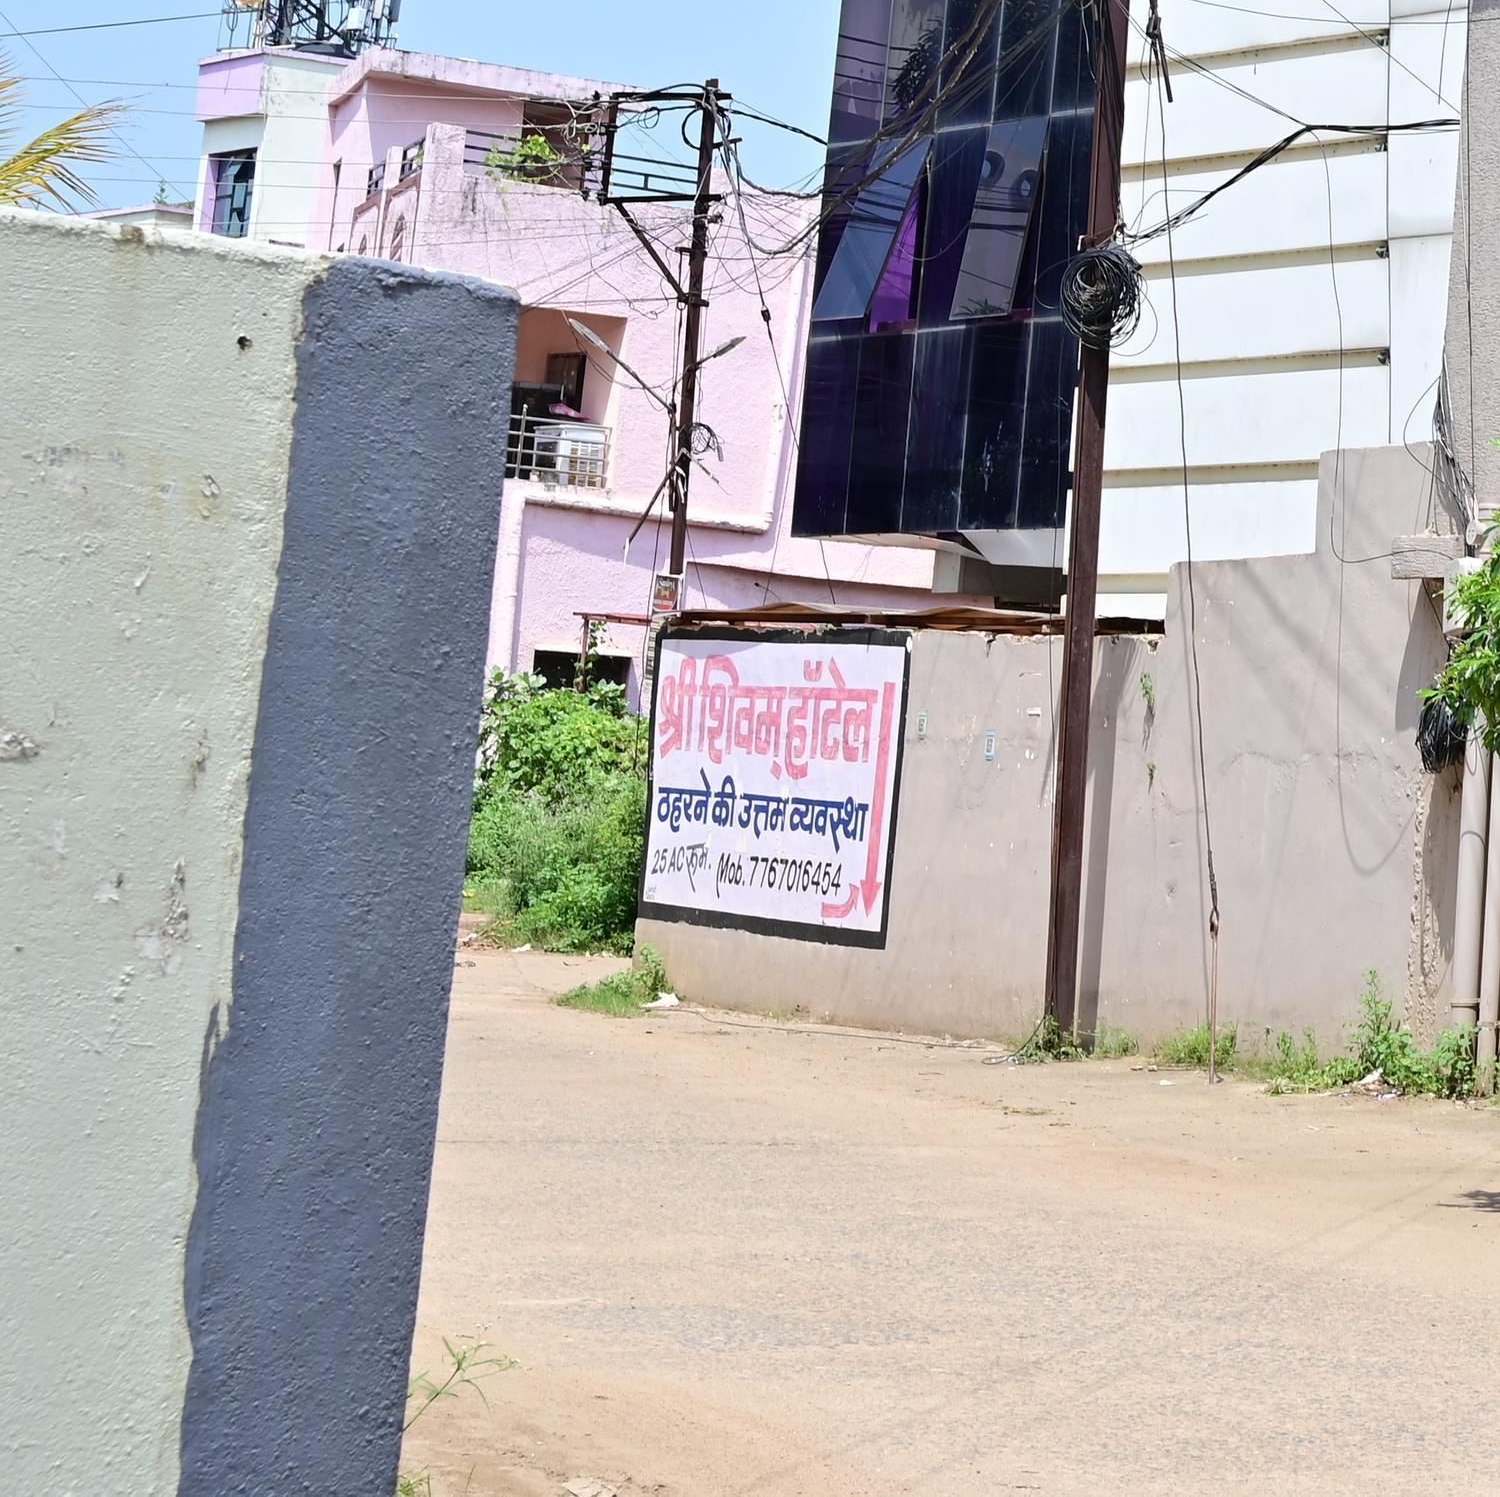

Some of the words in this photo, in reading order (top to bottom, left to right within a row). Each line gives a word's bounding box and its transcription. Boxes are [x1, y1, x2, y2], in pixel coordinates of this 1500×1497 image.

[658, 655, 698, 760] श्री
[784, 656, 879, 780] हॉटेल
[657, 766, 712, 833] ठहरने
[711, 774, 737, 828] की
[737, 792, 790, 840] उत्तम
[789, 795, 870, 854] व्यवस्था
[650, 848, 669, 875] 25
[667, 845, 685, 875] AC
[715, 852, 745, 899] Mob.
[748, 855, 843, 898] 7767016454
